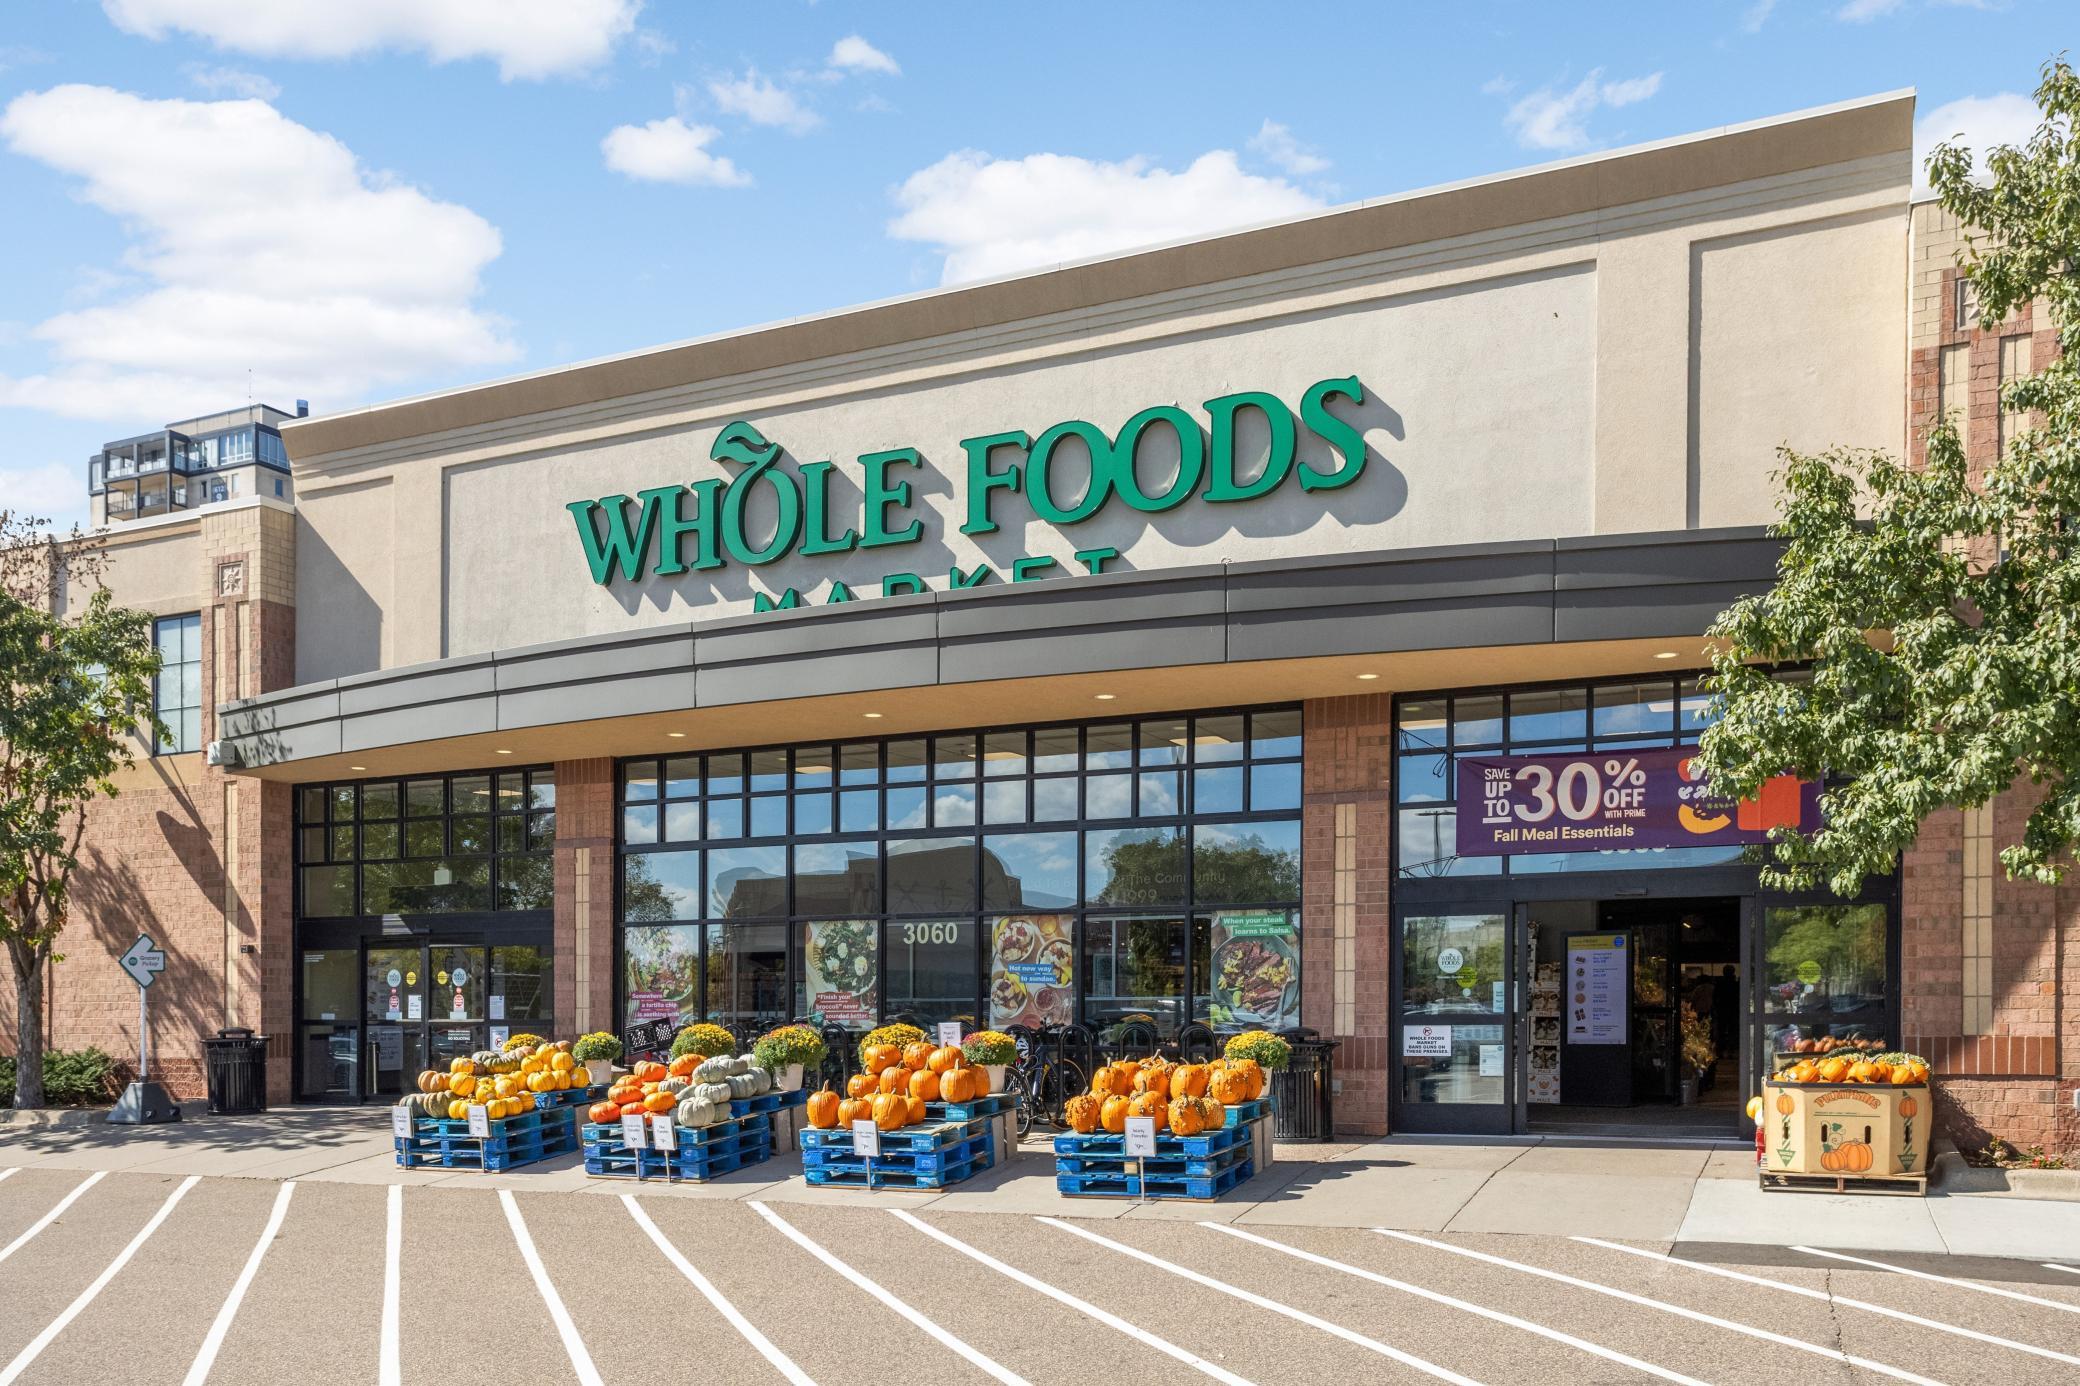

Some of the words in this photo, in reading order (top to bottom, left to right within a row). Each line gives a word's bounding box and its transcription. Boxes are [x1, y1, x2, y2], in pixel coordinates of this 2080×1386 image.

[566, 420, 925, 586] WHOLE
[959, 375, 1370, 536] FOODS
[1484, 768, 1511, 780] SAVE
[1485, 781, 1512, 798] UP
[1603, 788, 1646, 809] OFF
[1483, 799, 1511, 817] TO
[1604, 810, 1622, 819] WITH
[1624, 808, 1646, 818] PRIME
[1494, 829, 1519, 842] Fall
[1522, 827, 1558, 841] Meal
[1561, 823, 1635, 839] Essentials
[1155, 870, 1226, 885] Comunity
[903, 922, 958, 944] 3060
